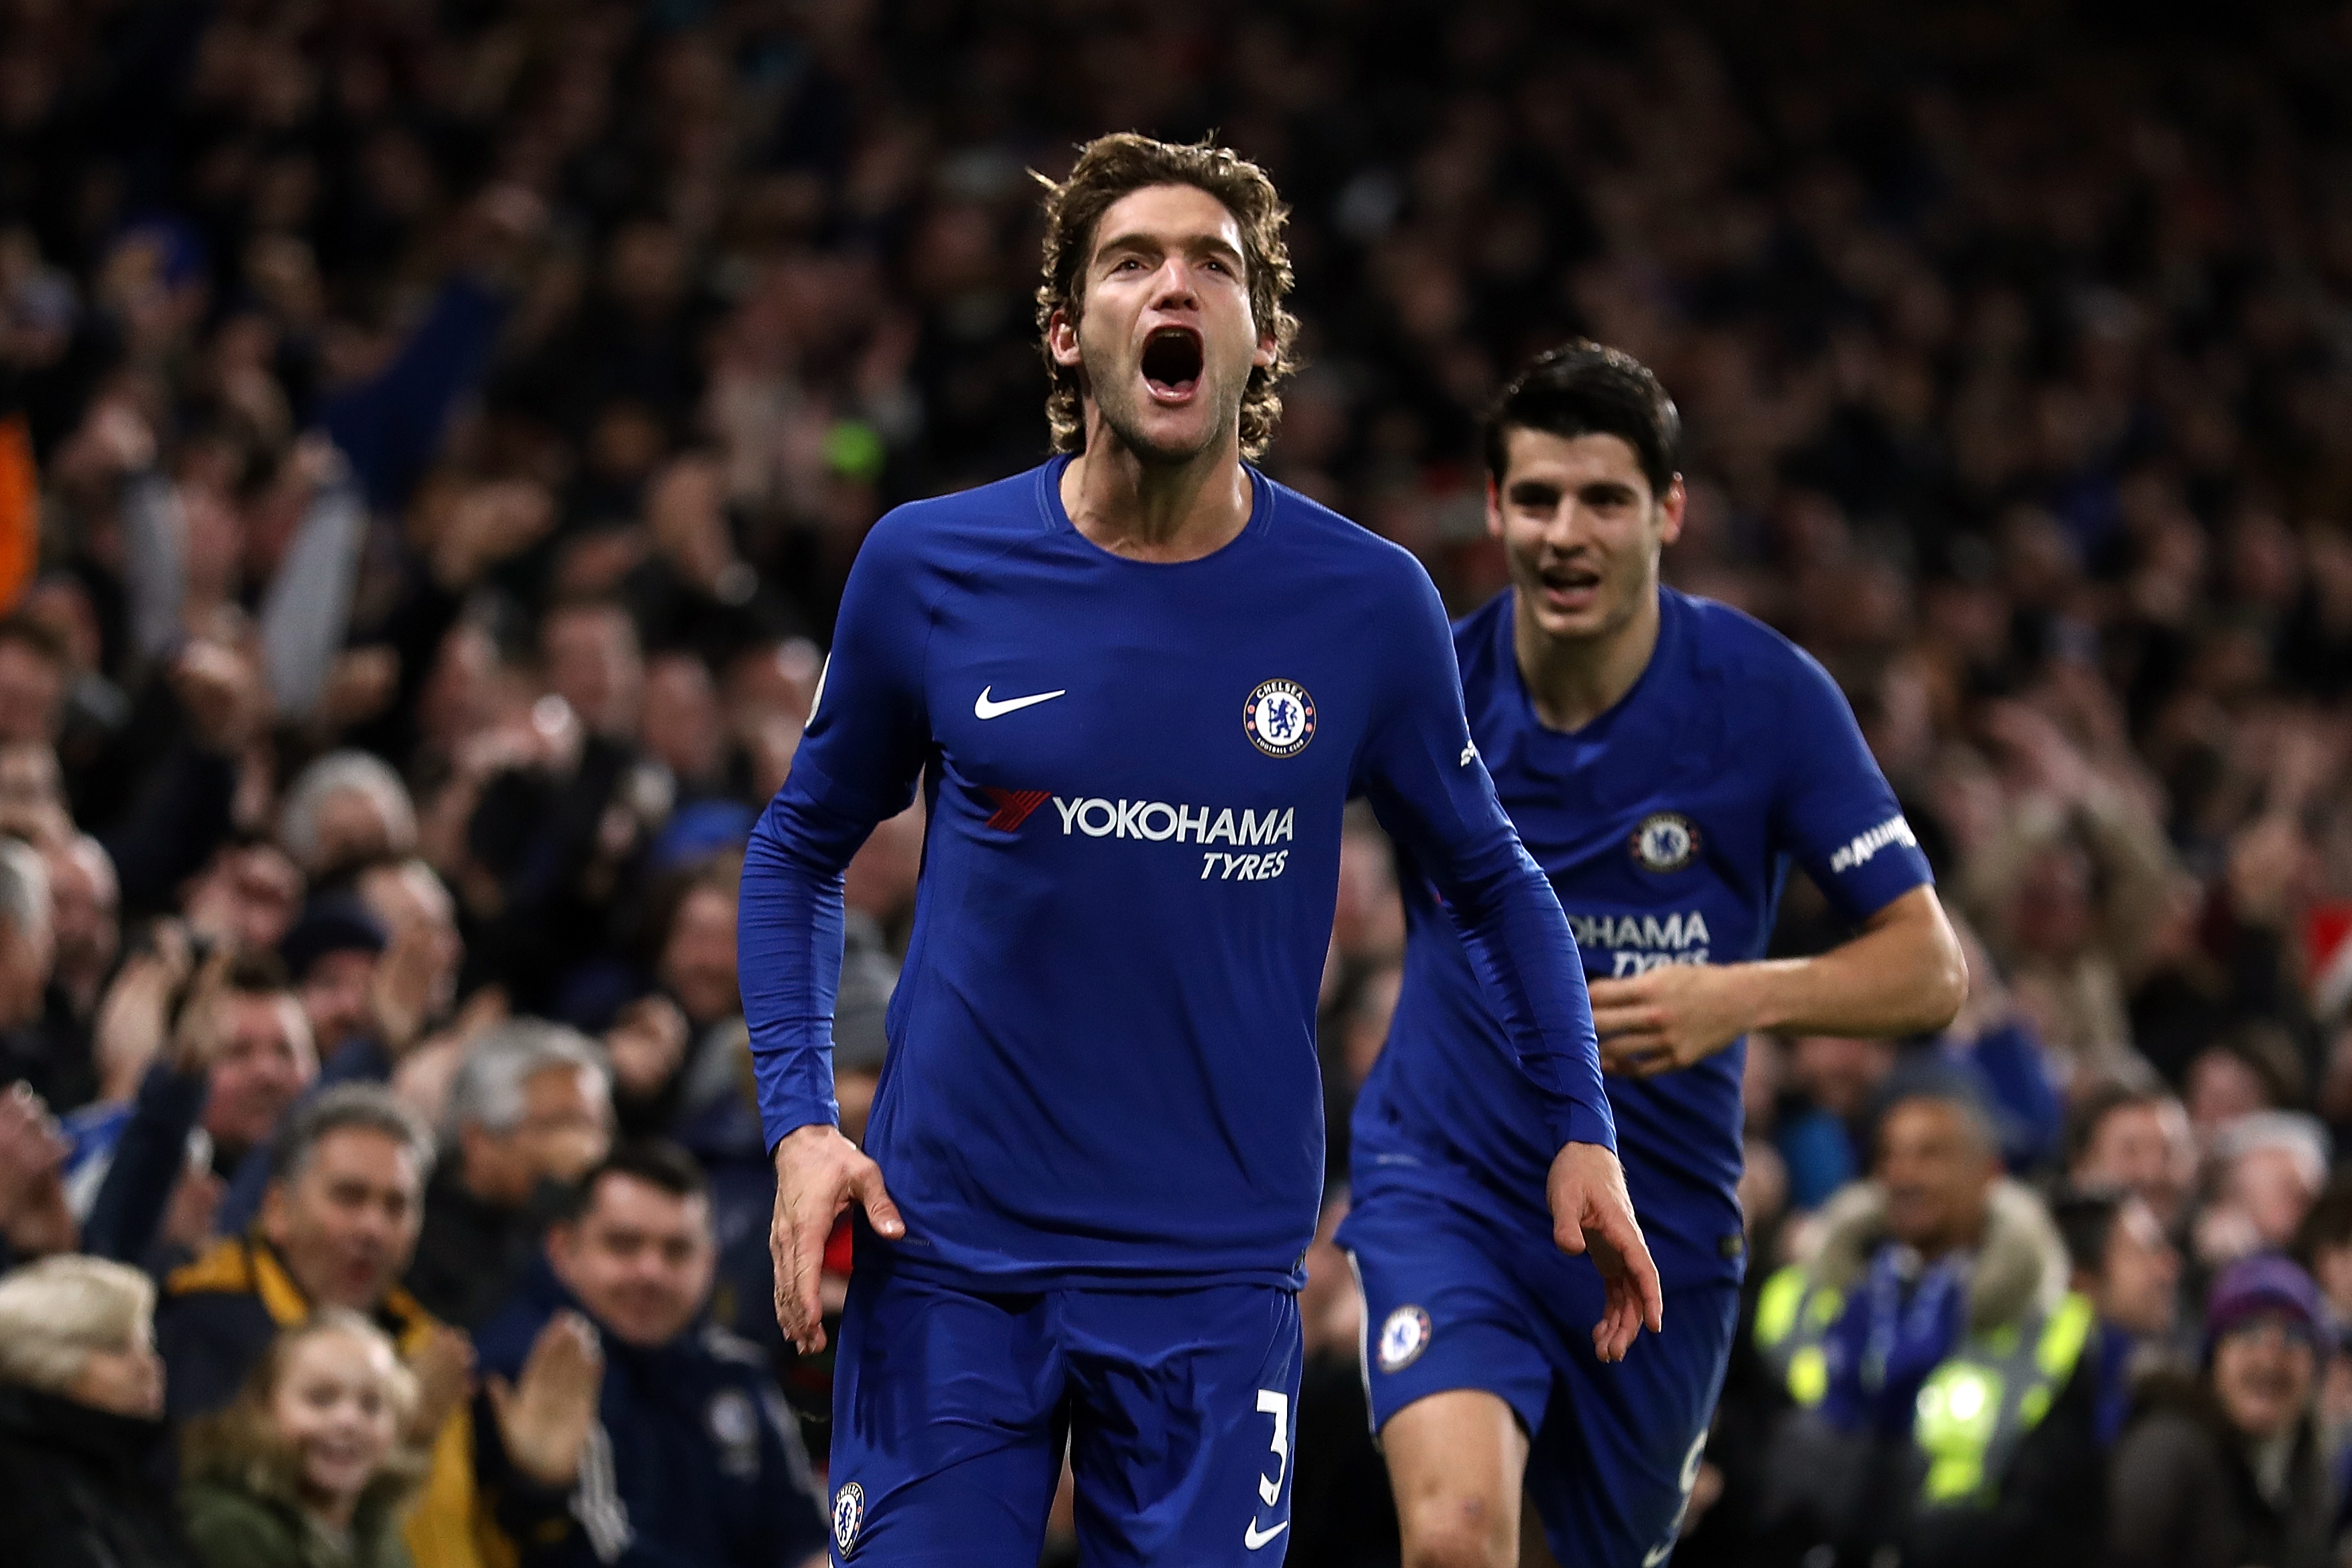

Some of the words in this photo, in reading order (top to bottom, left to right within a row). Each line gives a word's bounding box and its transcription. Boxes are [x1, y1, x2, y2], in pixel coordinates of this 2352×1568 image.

[1256, 682, 1303, 700] CHELSEA
[1052, 796, 1294, 846] YOKOHAMA
[1200, 849, 1288, 881] TYRES
[1256, 1388, 1288, 1507] 3
[836, 1485, 860, 1503] CHELSEA
